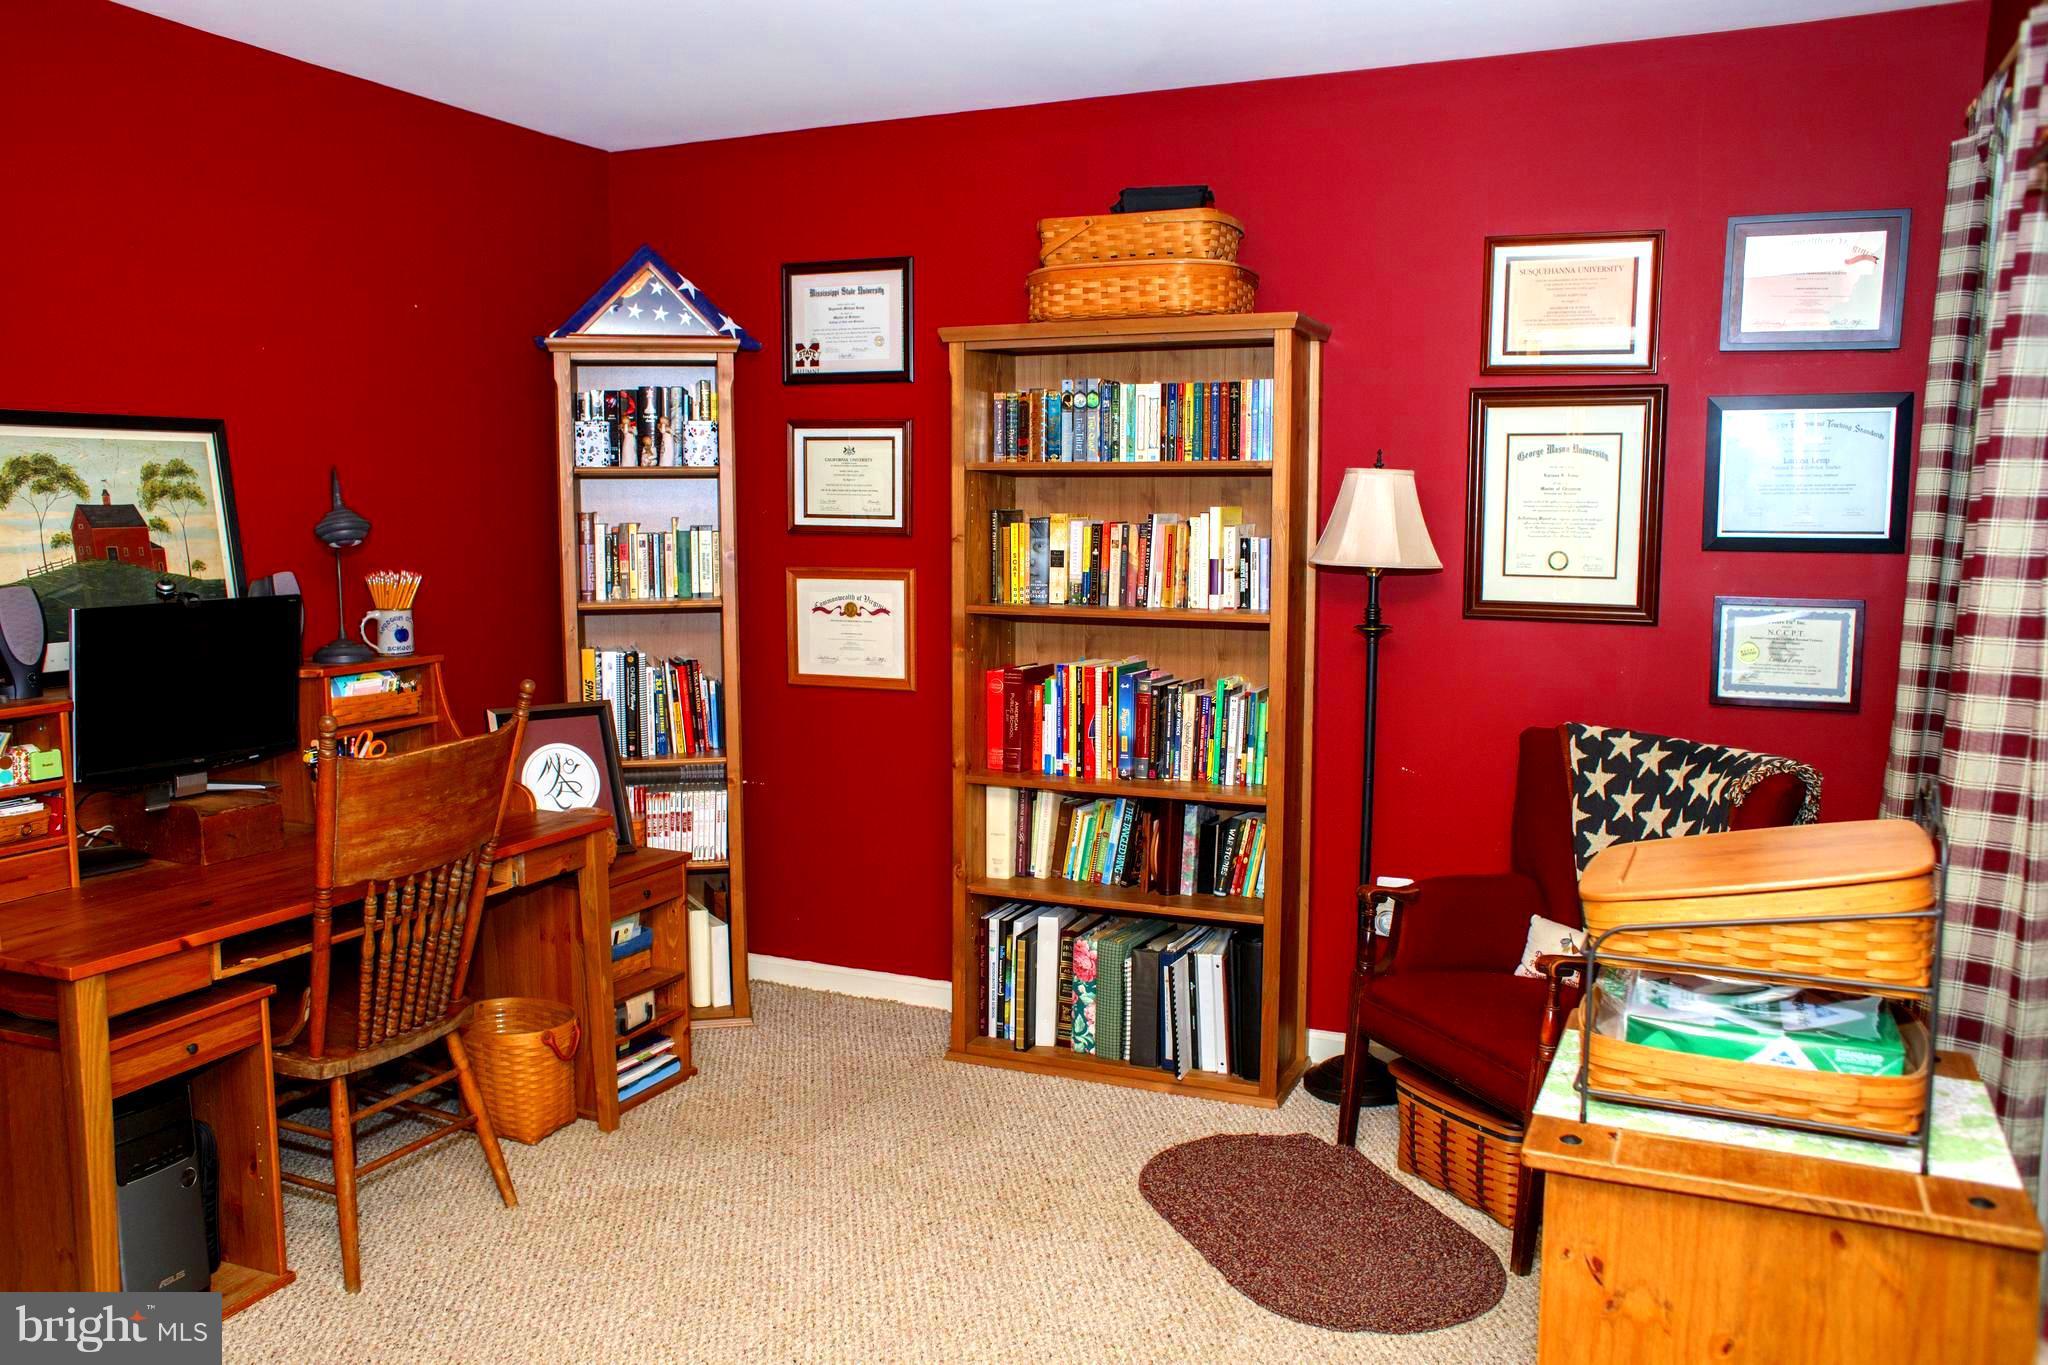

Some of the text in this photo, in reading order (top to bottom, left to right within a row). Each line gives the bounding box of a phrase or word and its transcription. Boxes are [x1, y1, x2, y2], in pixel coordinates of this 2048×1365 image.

[1577, 265, 1625, 274] UNIVERSITY
[841, 286, 855, 296] State
[857, 285, 885, 296] University
[798, 350, 817, 358] STATE
[1853, 424, 1885, 440] Standards
[1517, 448, 1544, 461] George
[1572, 443, 1609, 462] University
[1114, 807, 1133, 873] THE TANGLED WING
[1221, 829, 1236, 876] WAR STORIES
[159, 1270, 186, 1288] ASUS
